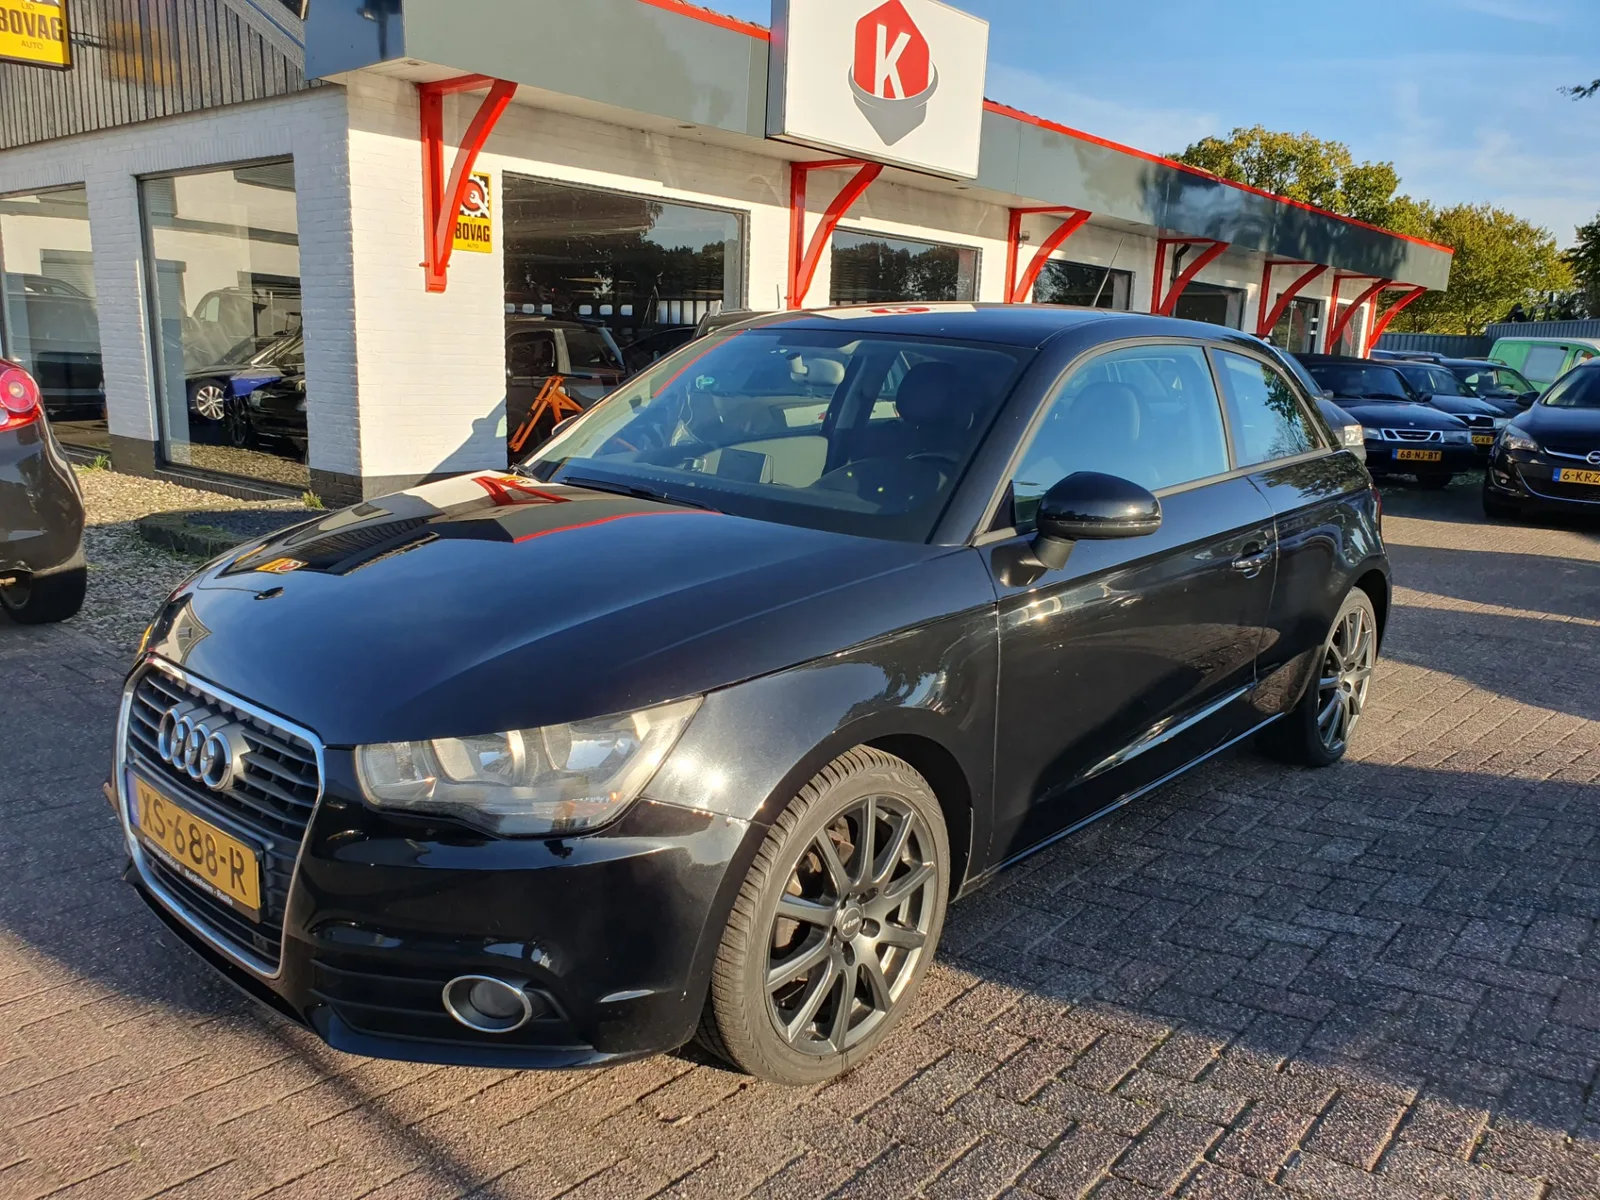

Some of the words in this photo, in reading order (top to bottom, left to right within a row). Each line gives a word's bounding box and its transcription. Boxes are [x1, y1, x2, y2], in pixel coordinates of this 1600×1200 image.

[0, 7, 64, 42] BOVAG
[21, 40, 44, 50] AUTO
[873, 23, 911, 99] K
[455, 222, 490, 242] BOVAG
[1400, 450, 1438, 460] 68-NJ-BT
[141, 788, 247, 896] XS-688-R
